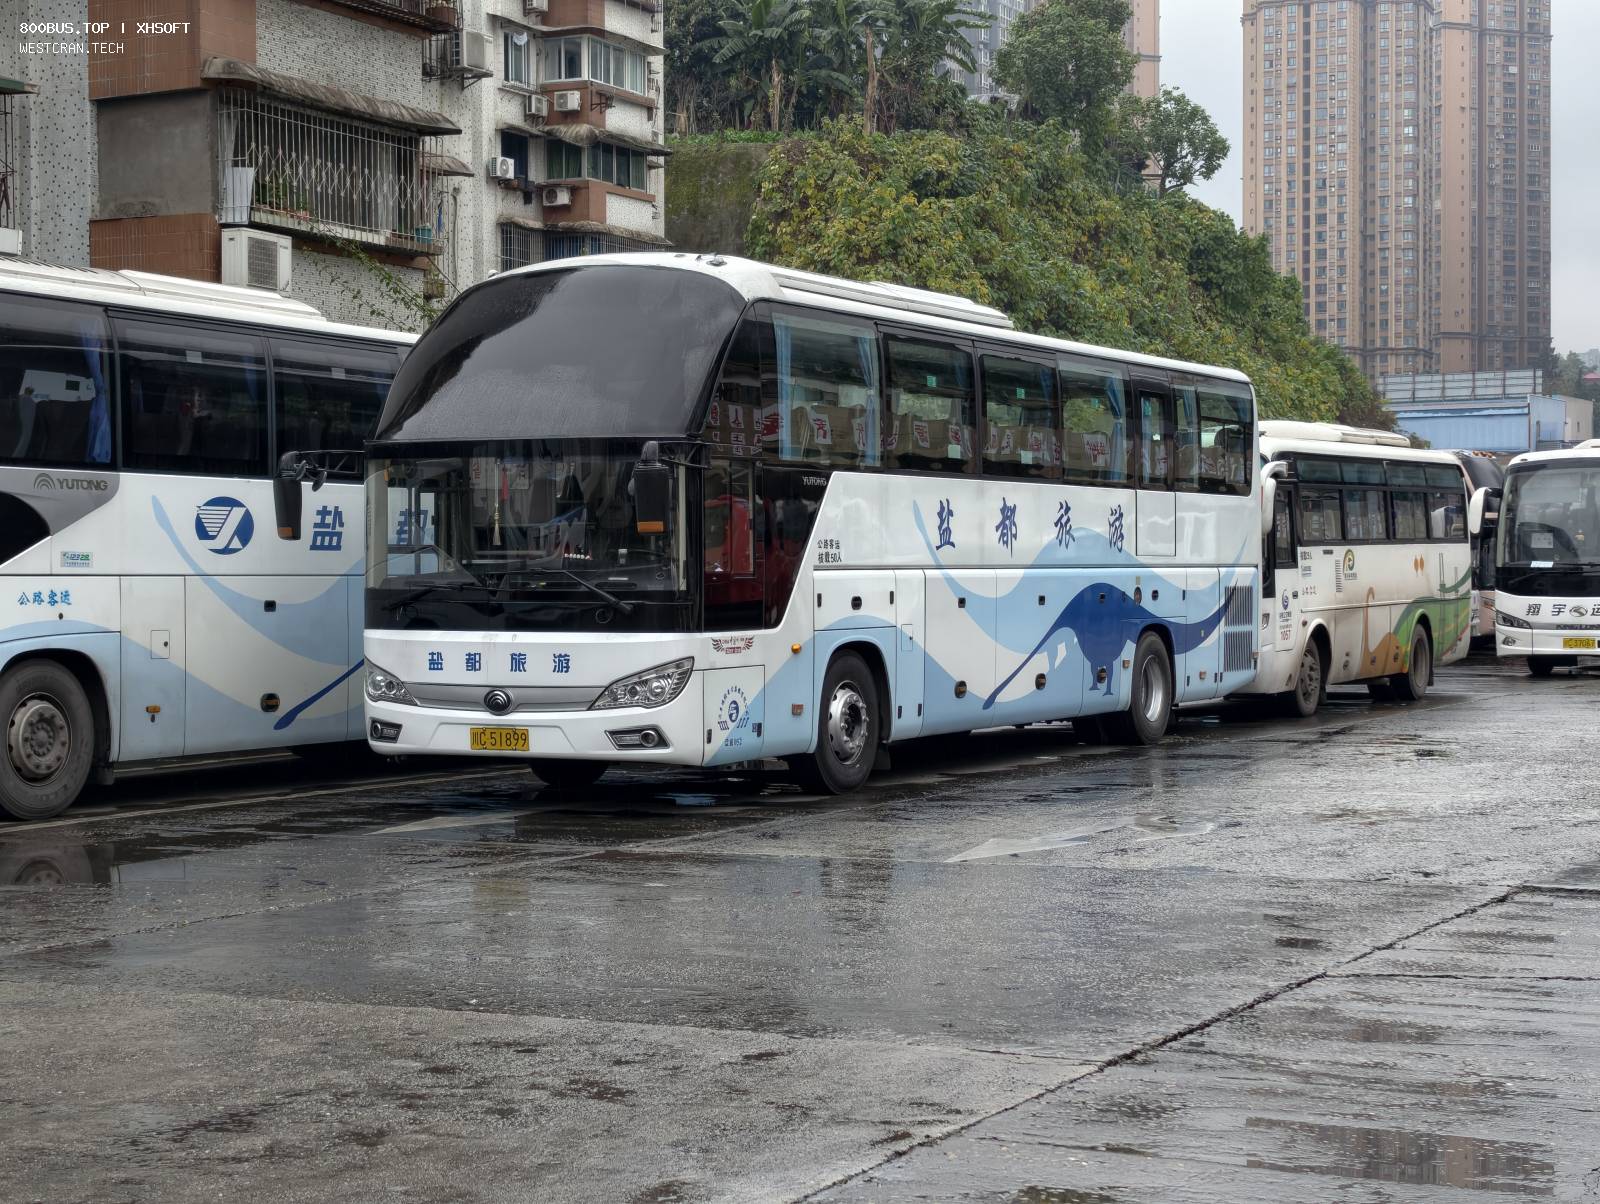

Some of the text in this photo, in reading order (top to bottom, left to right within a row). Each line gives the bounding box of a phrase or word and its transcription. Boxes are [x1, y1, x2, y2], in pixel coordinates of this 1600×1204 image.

[56, 479, 109, 491] YUTONG
[802, 476, 827, 486] YUTONG
[935, 497, 1125, 558] 盐都旅游
[817, 539, 841, 550] 公路客运
[17, 589, 72, 606] 公路客运
[428, 651, 571, 674] 盐都旅游
